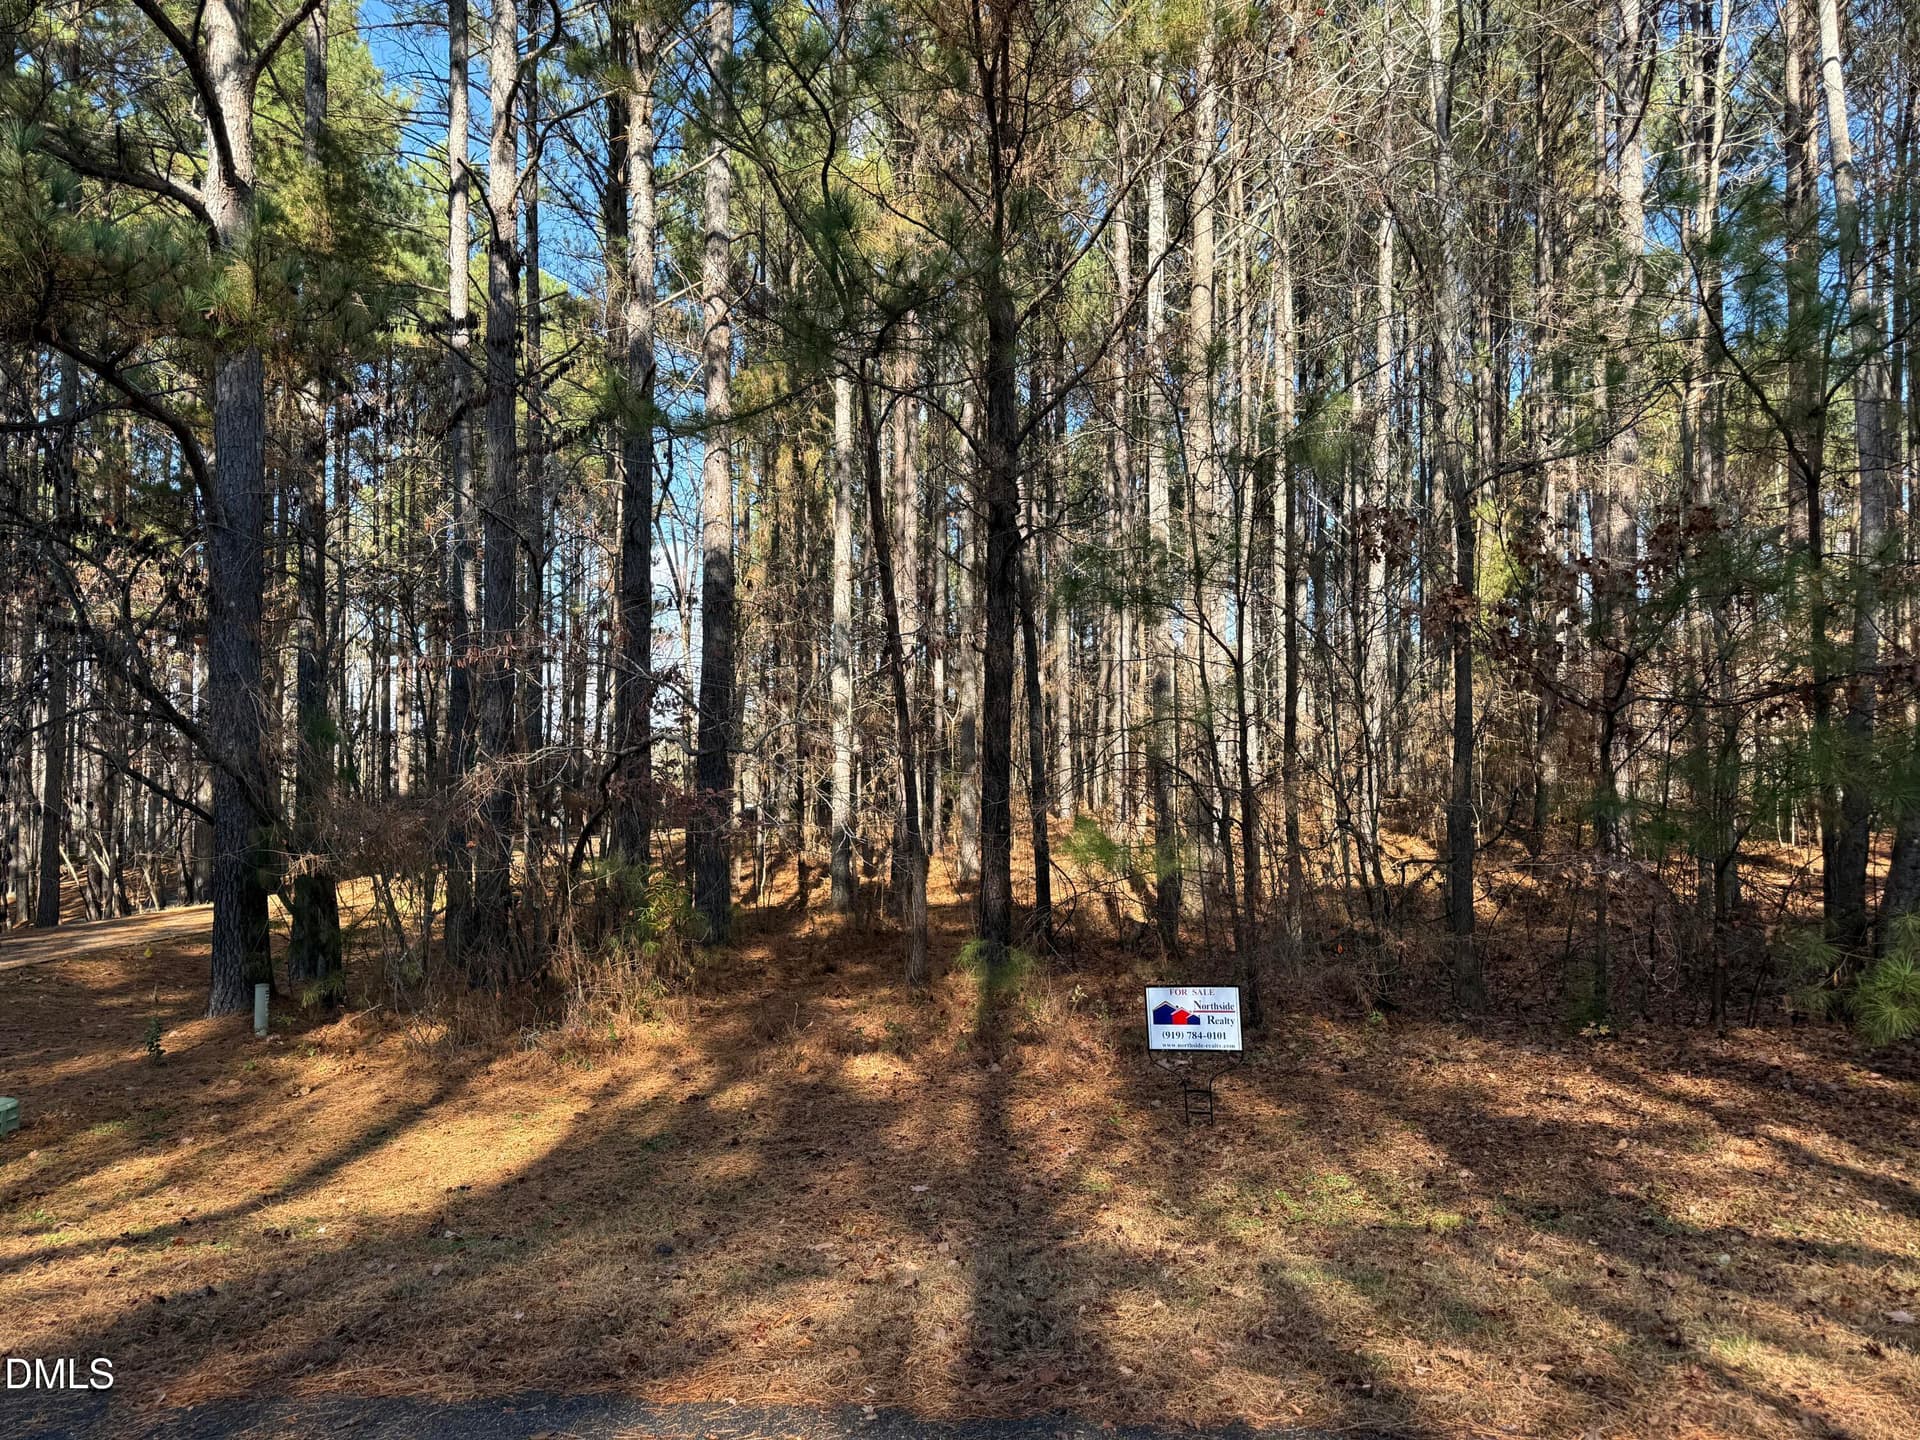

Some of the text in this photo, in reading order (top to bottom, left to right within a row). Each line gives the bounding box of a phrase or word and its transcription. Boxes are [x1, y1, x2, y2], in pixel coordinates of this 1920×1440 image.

[1169, 988, 1215, 996] FOR SALE
[1193, 1000, 1235, 1010] Northside
[1207, 1015, 1235, 1027] Realty
[1162, 1031, 1226, 1040] (919) 784-0101
